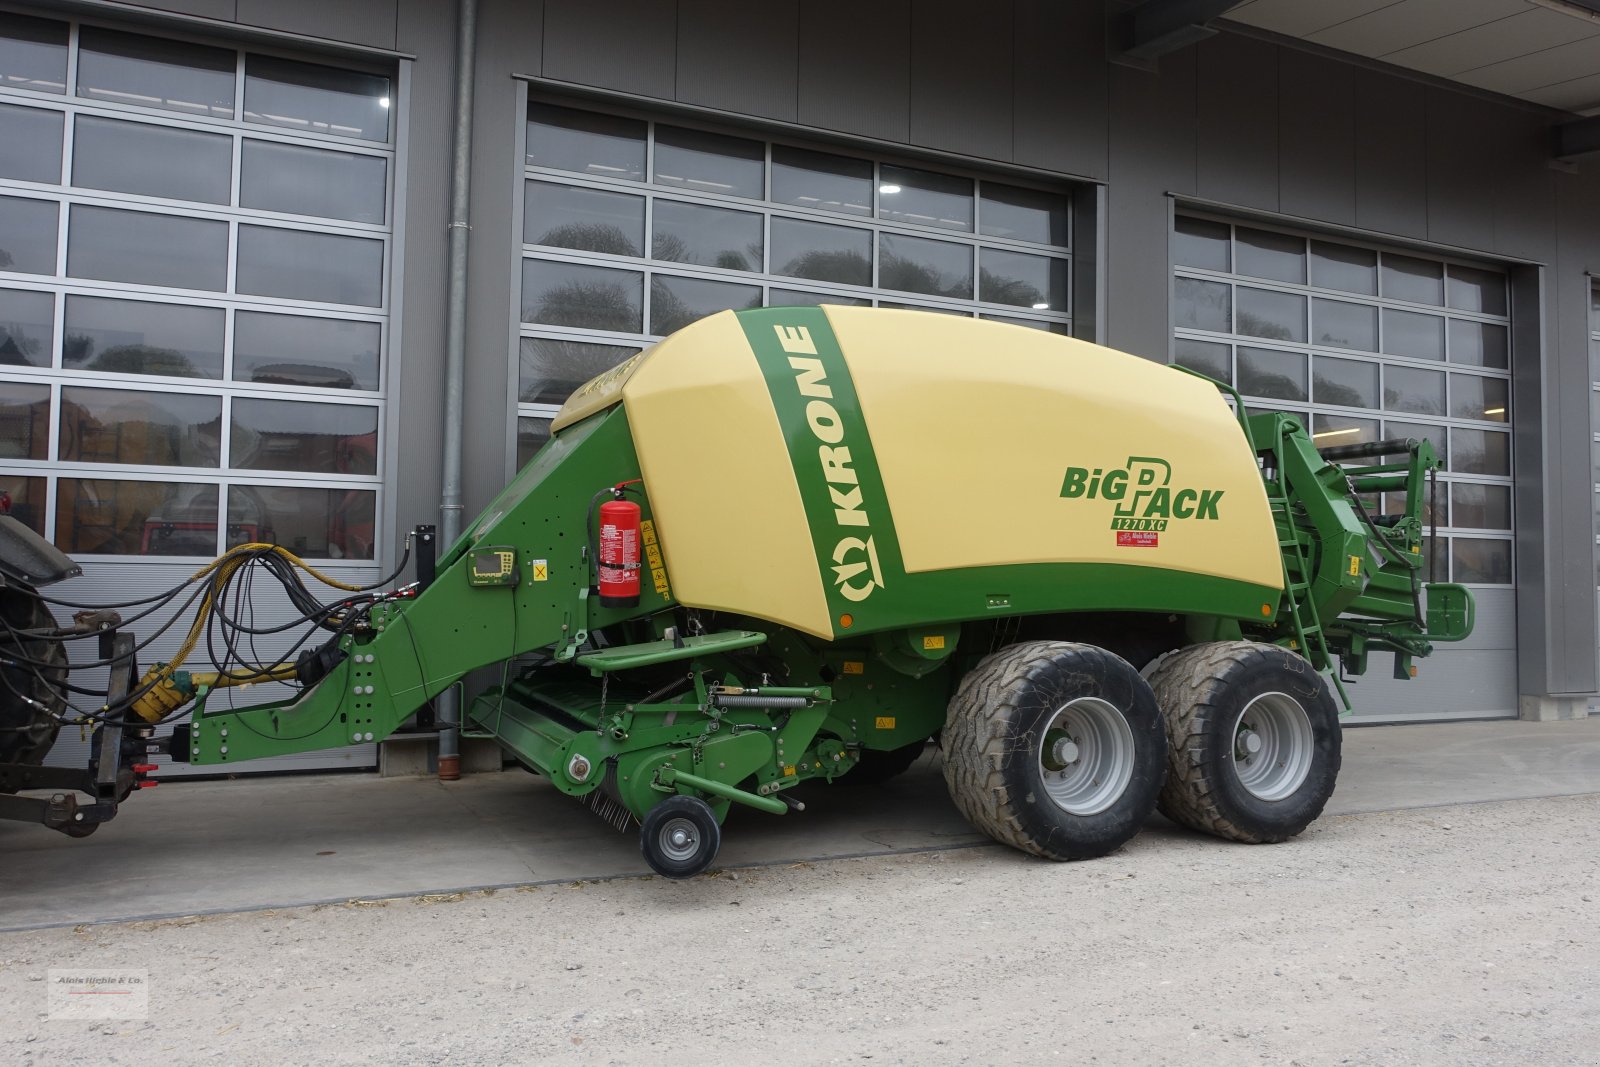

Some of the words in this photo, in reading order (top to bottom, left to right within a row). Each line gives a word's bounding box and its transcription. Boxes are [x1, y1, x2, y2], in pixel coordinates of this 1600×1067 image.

[773, 324, 870, 527] KRONE
[1116, 518, 1146, 531] 1270
[1149, 519, 1165, 531] XC
